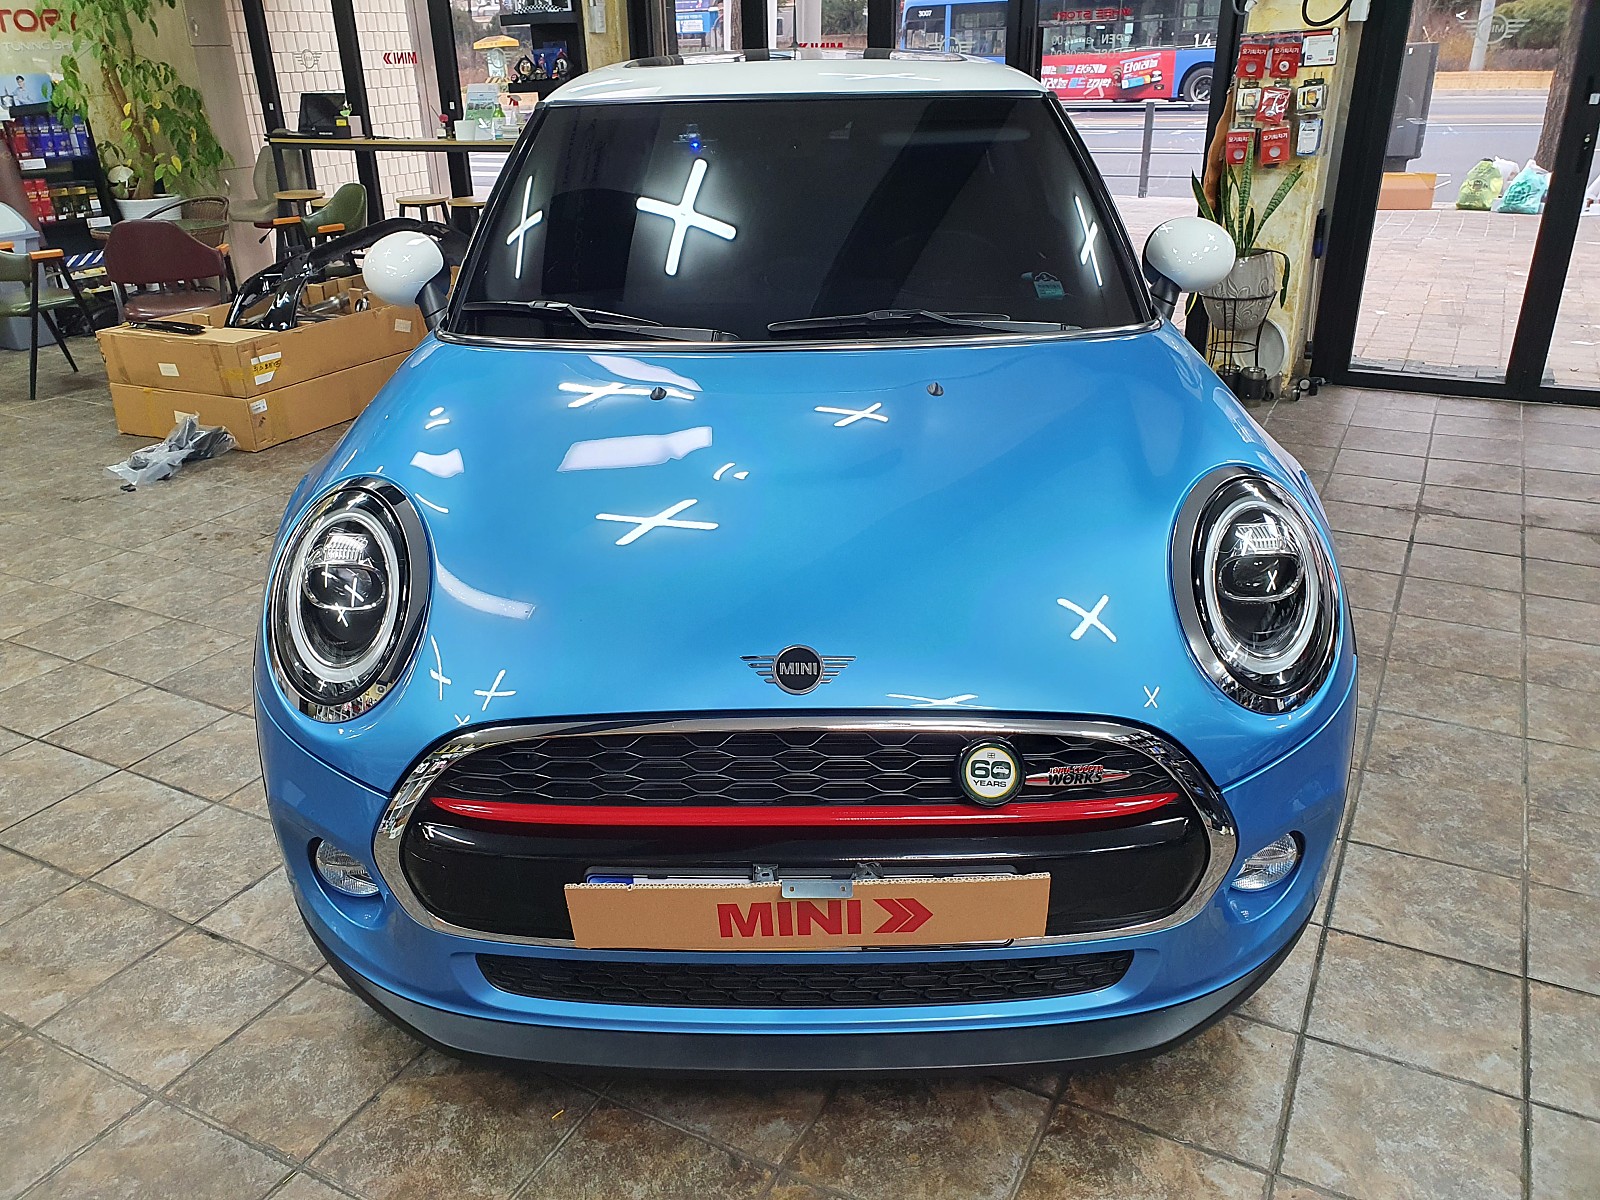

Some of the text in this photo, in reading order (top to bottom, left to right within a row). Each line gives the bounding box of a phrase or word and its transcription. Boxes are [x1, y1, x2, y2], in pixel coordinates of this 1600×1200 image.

[1193, 32, 1217, 49] 14
[779, 662, 818, 676] MINI
[970, 759, 1012, 780] 60
[973, 779, 1007, 788] YEARS
[1048, 772, 1103, 785] WORKS
[716, 898, 862, 938] MINI
